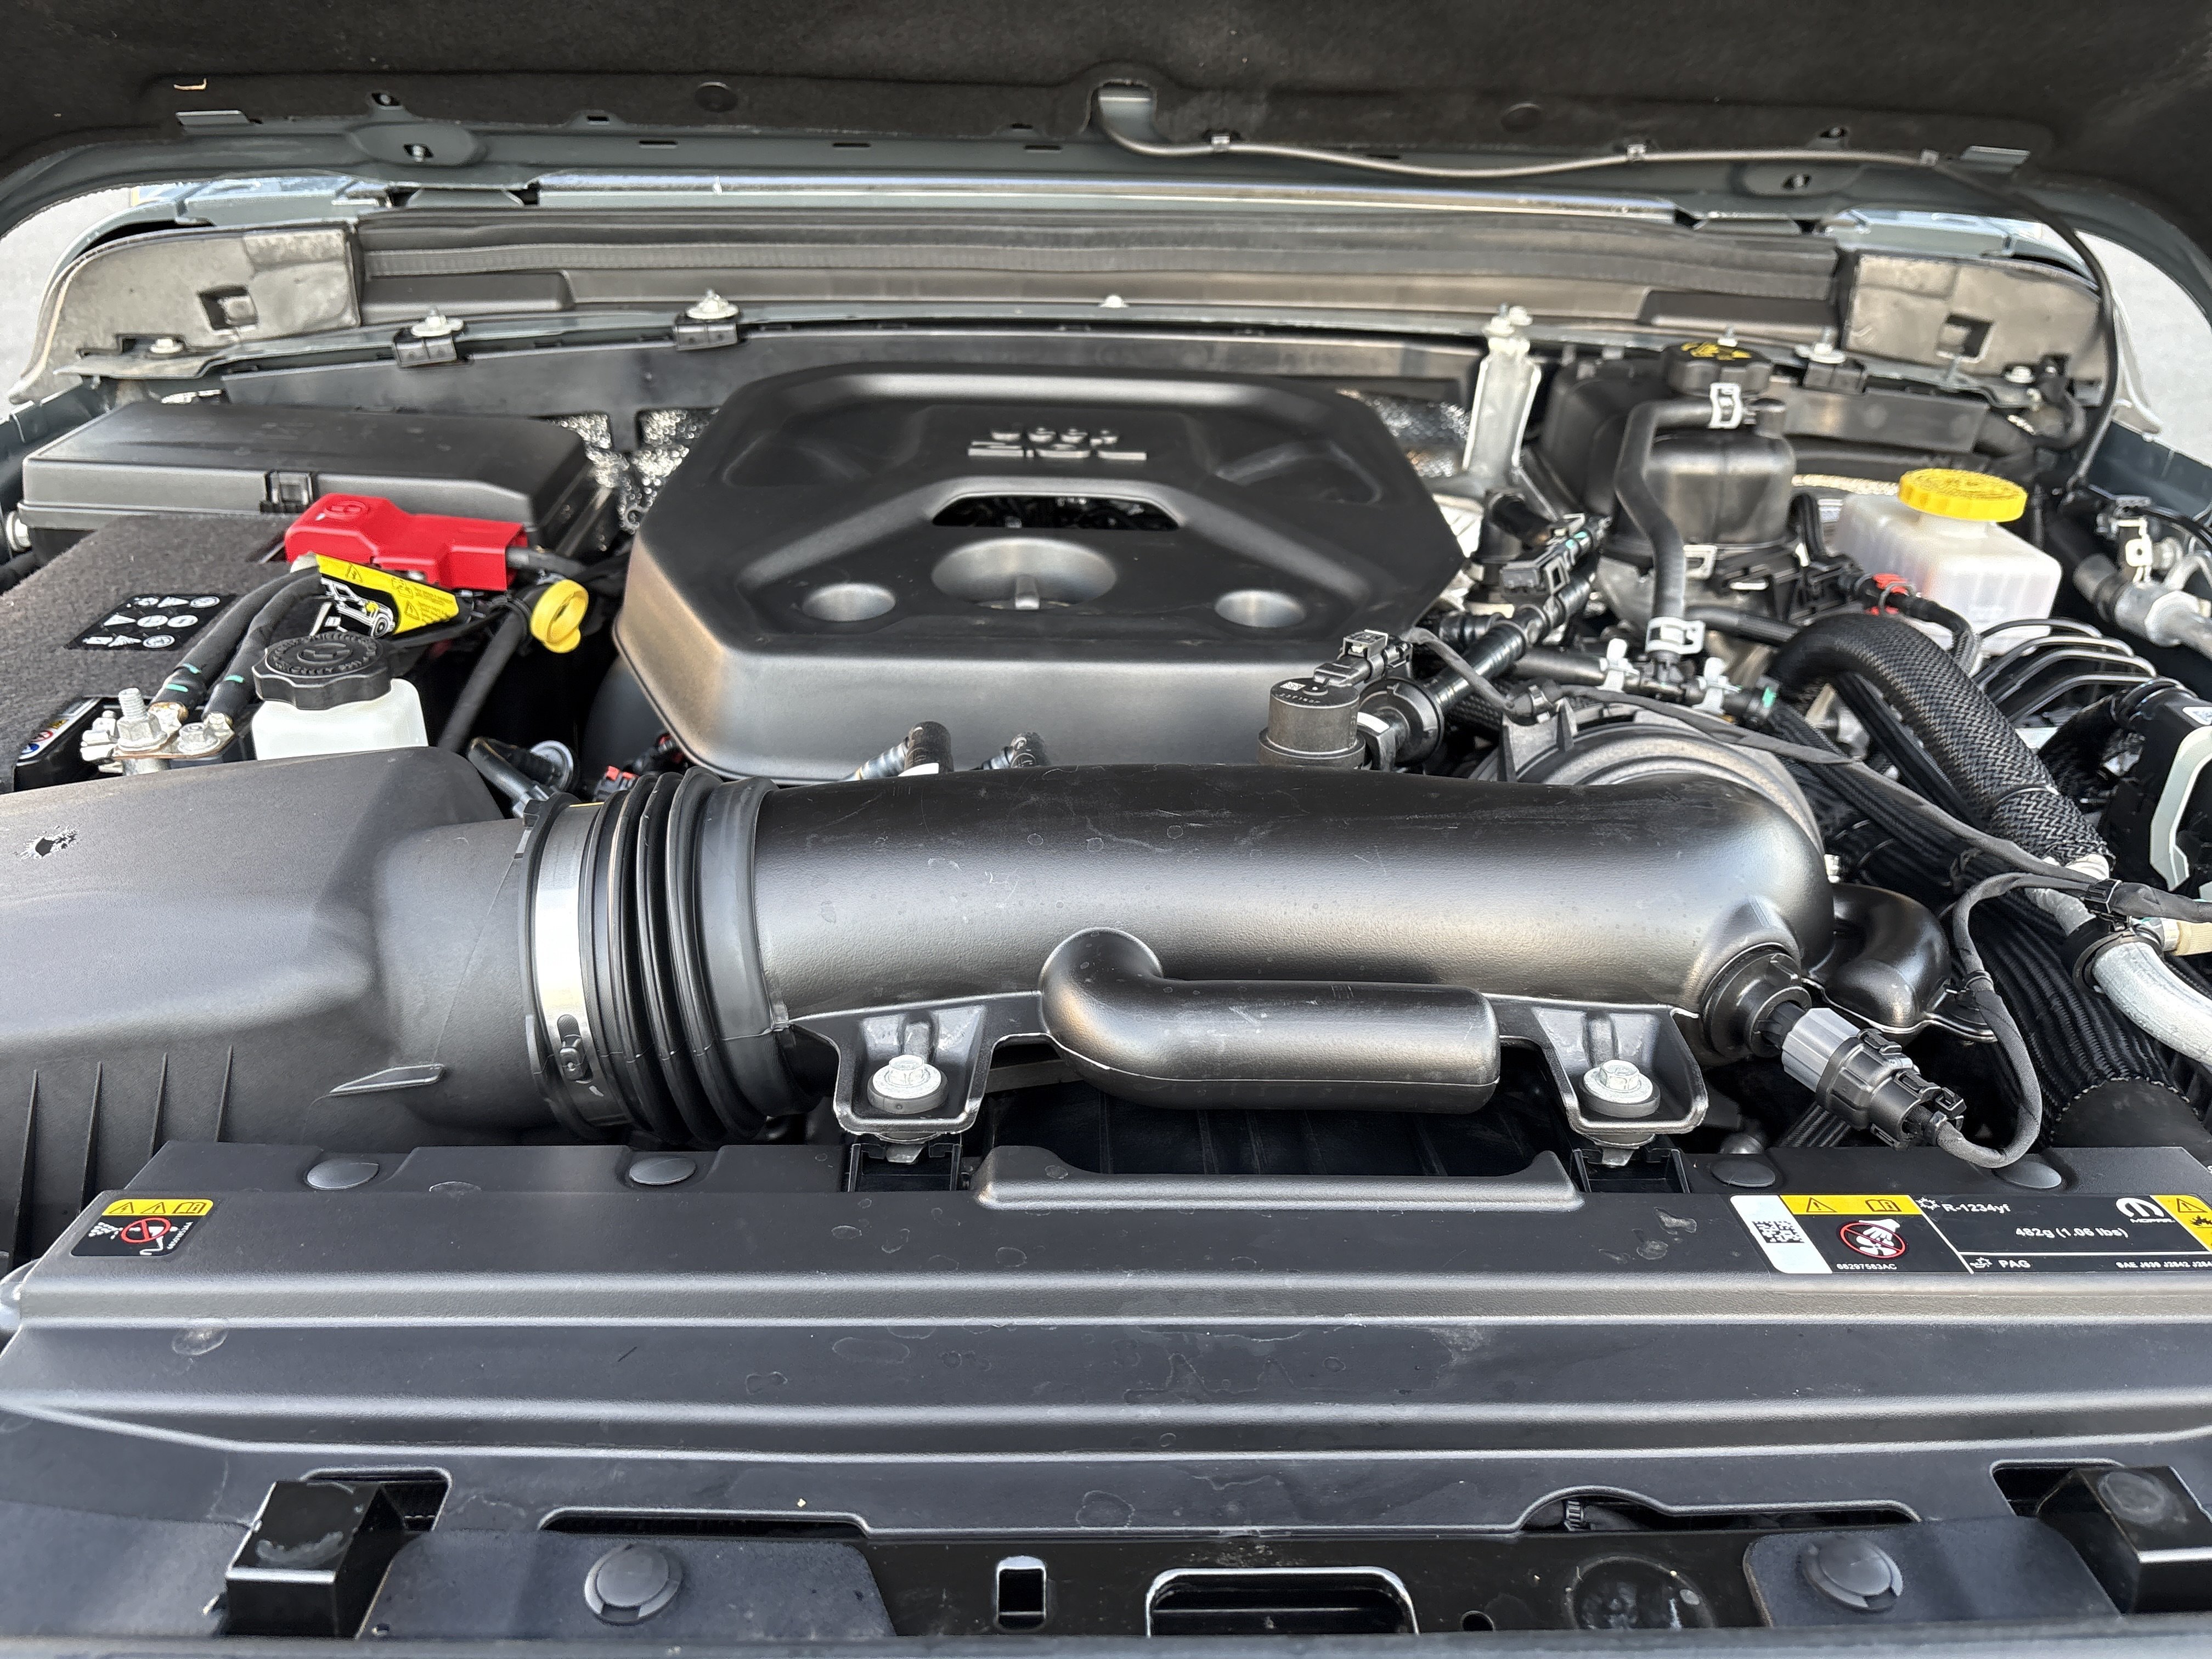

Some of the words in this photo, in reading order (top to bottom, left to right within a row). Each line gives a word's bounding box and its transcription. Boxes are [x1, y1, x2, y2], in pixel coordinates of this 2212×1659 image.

[1942, 1204, 2011, 1214] R-1234yf
[2016, 1228, 2055, 1238] 482g
[2055, 1227, 2095, 1238] (1.06
[2095, 1227, 2129, 1238] lbs)
[1998, 1260, 2031, 1268] PAG
